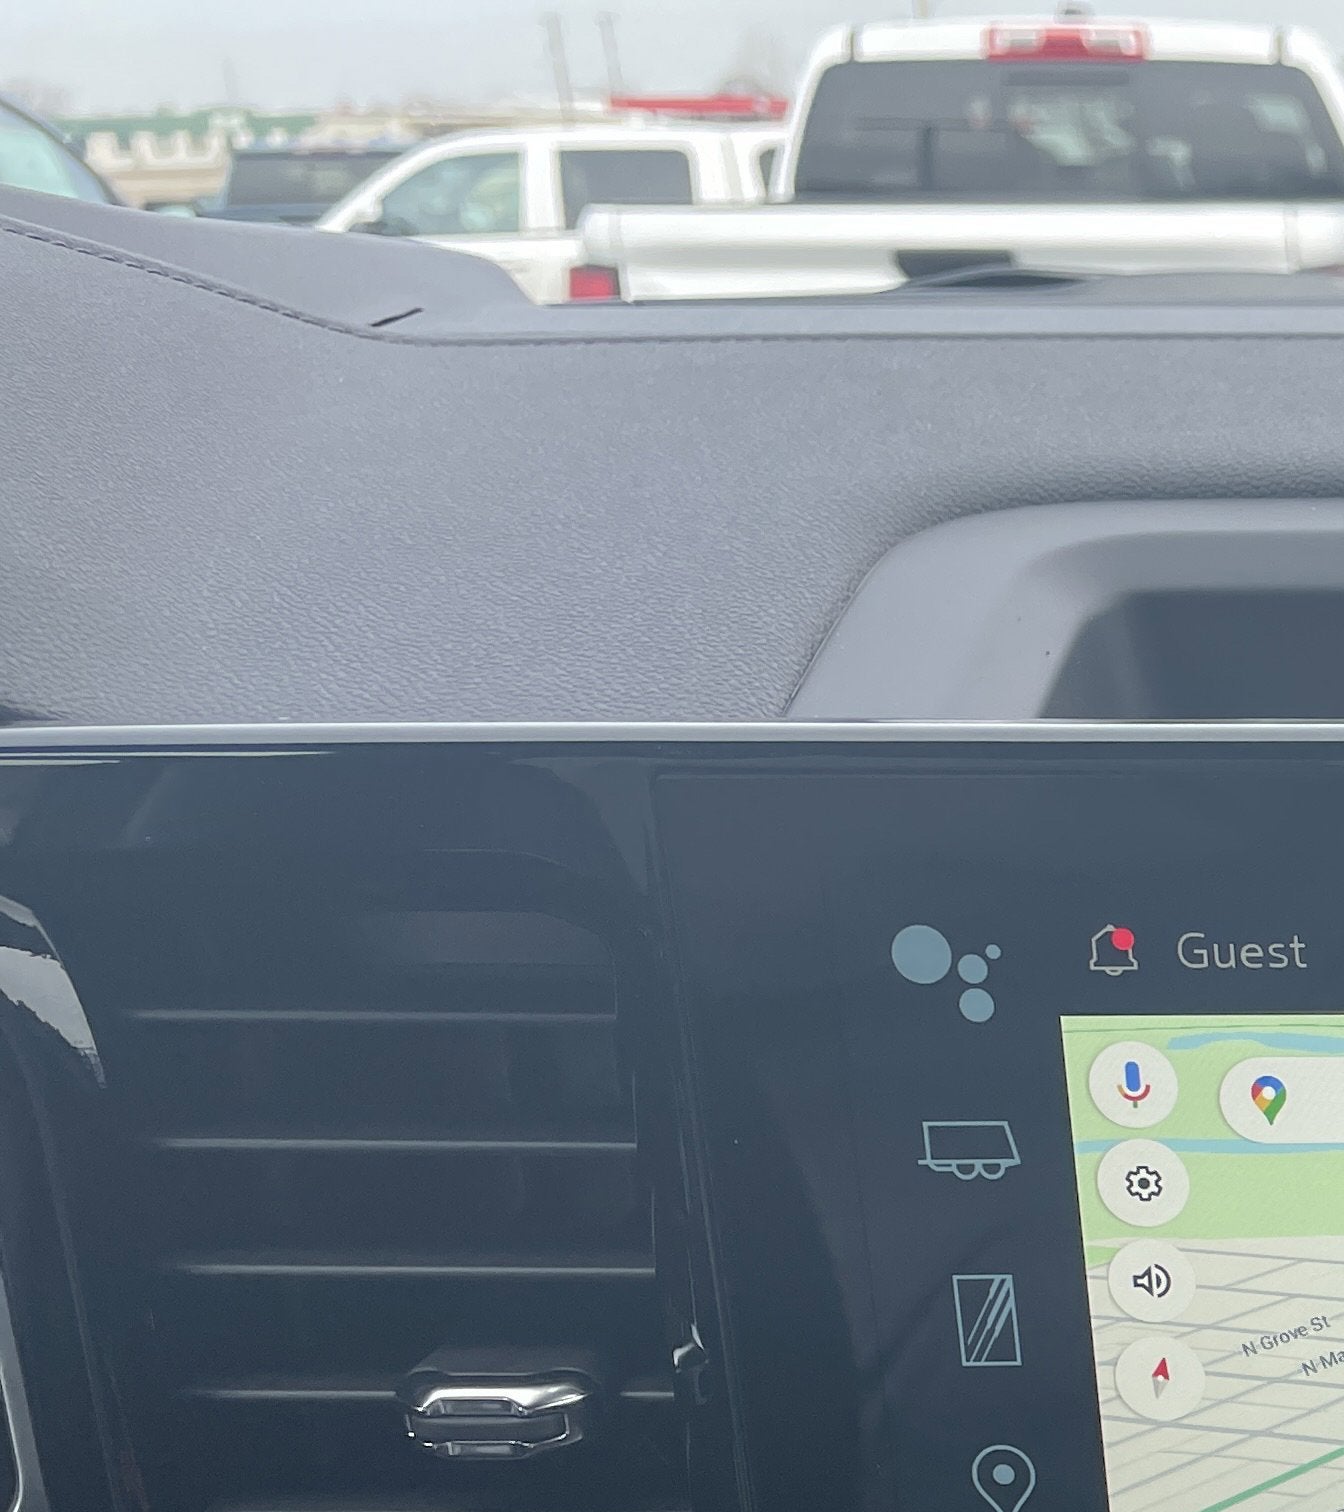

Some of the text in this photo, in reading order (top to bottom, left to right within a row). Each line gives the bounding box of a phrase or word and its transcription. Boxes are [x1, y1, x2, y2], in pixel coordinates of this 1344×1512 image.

[1177, 931, 1307, 970] Guest
[1241, 1314, 1332, 1358] N Grove St
[1301, 1359, 1318, 1376] N
